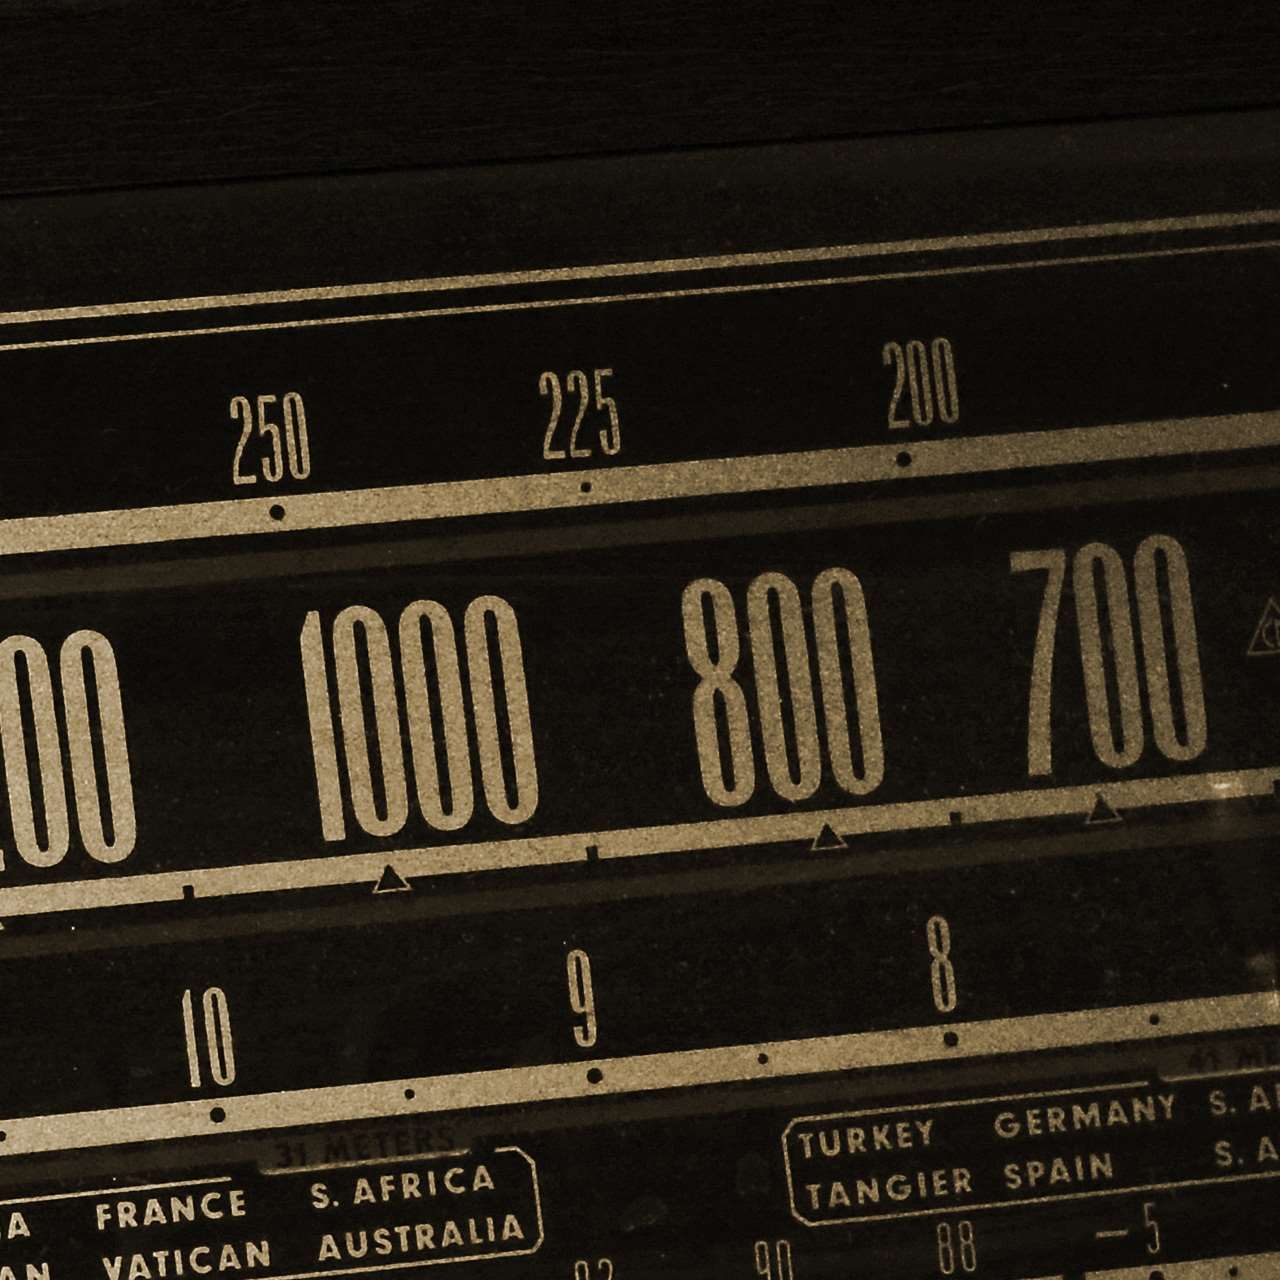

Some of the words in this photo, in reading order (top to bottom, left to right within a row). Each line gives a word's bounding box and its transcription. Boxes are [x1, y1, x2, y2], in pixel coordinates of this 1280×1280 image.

[539, 369, 621, 460] 225
[883, 337, 959, 429] 200
[230, 392, 310, 485] 250
[682, 568, 884, 806] 800
[1011, 535, 1207, 776] 700
[300, 595, 538, 841] 1000
[567, 950, 597, 1047] 9
[927, 916, 957, 1012] 8
[182, 987, 235, 1087] 10
[324, 1125, 457, 1163] METERS
[798, 1120, 932, 1158] TURKEY
[994, 1095, 1174, 1138] GERMANY
[1209, 1090, 1236, 1116] S.
[96, 1190, 245, 1230] FRANCE
[311, 1183, 339, 1209] S.
[354, 1165, 494, 1204] AFRICA
[806, 1168, 971, 1209] TANGIER
[1004, 1153, 1113, 1189] SPAIN
[1215, 1140, 1243, 1166] S.
[319, 1214, 524, 1261] AUSTRALIA
[937, 1220, 976, 1275] 88
